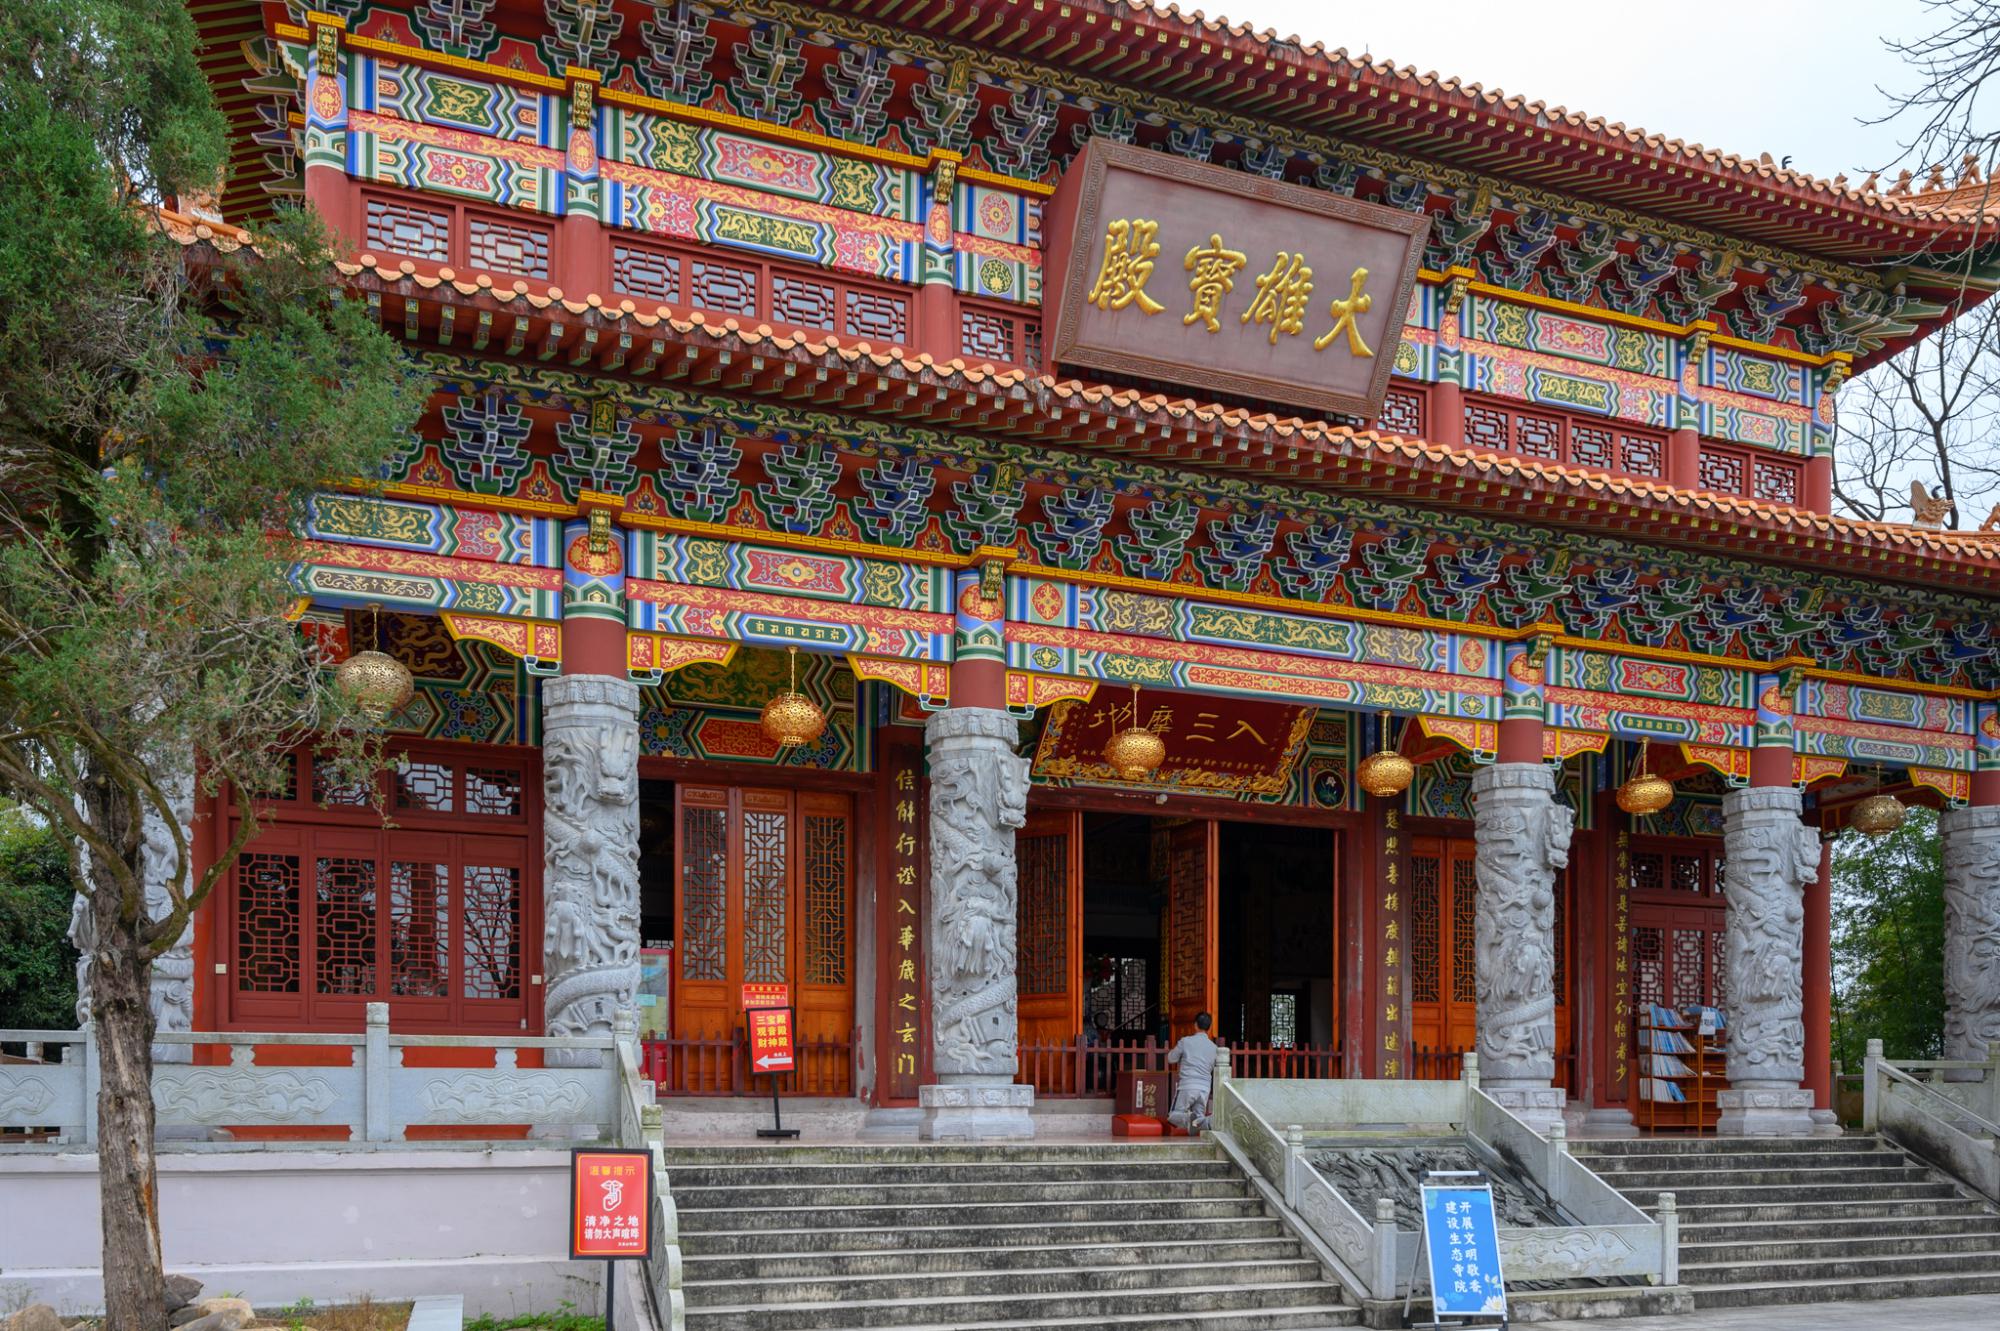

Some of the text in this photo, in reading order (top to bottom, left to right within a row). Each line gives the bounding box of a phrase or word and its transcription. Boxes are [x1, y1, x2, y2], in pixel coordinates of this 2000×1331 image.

[1088, 218, 1374, 358] 大雄寶殿
[756, 1014, 786, 1025] 三宝殿
[757, 1025, 787, 1037] 观音殿
[758, 1036, 788, 1048] 财神殿
[584, 1215, 639, 1227] 清净之地
[584, 1228, 640, 1240] 请勿大声喧哗
[1445, 1200, 1468, 1293] 建设生态寺院
